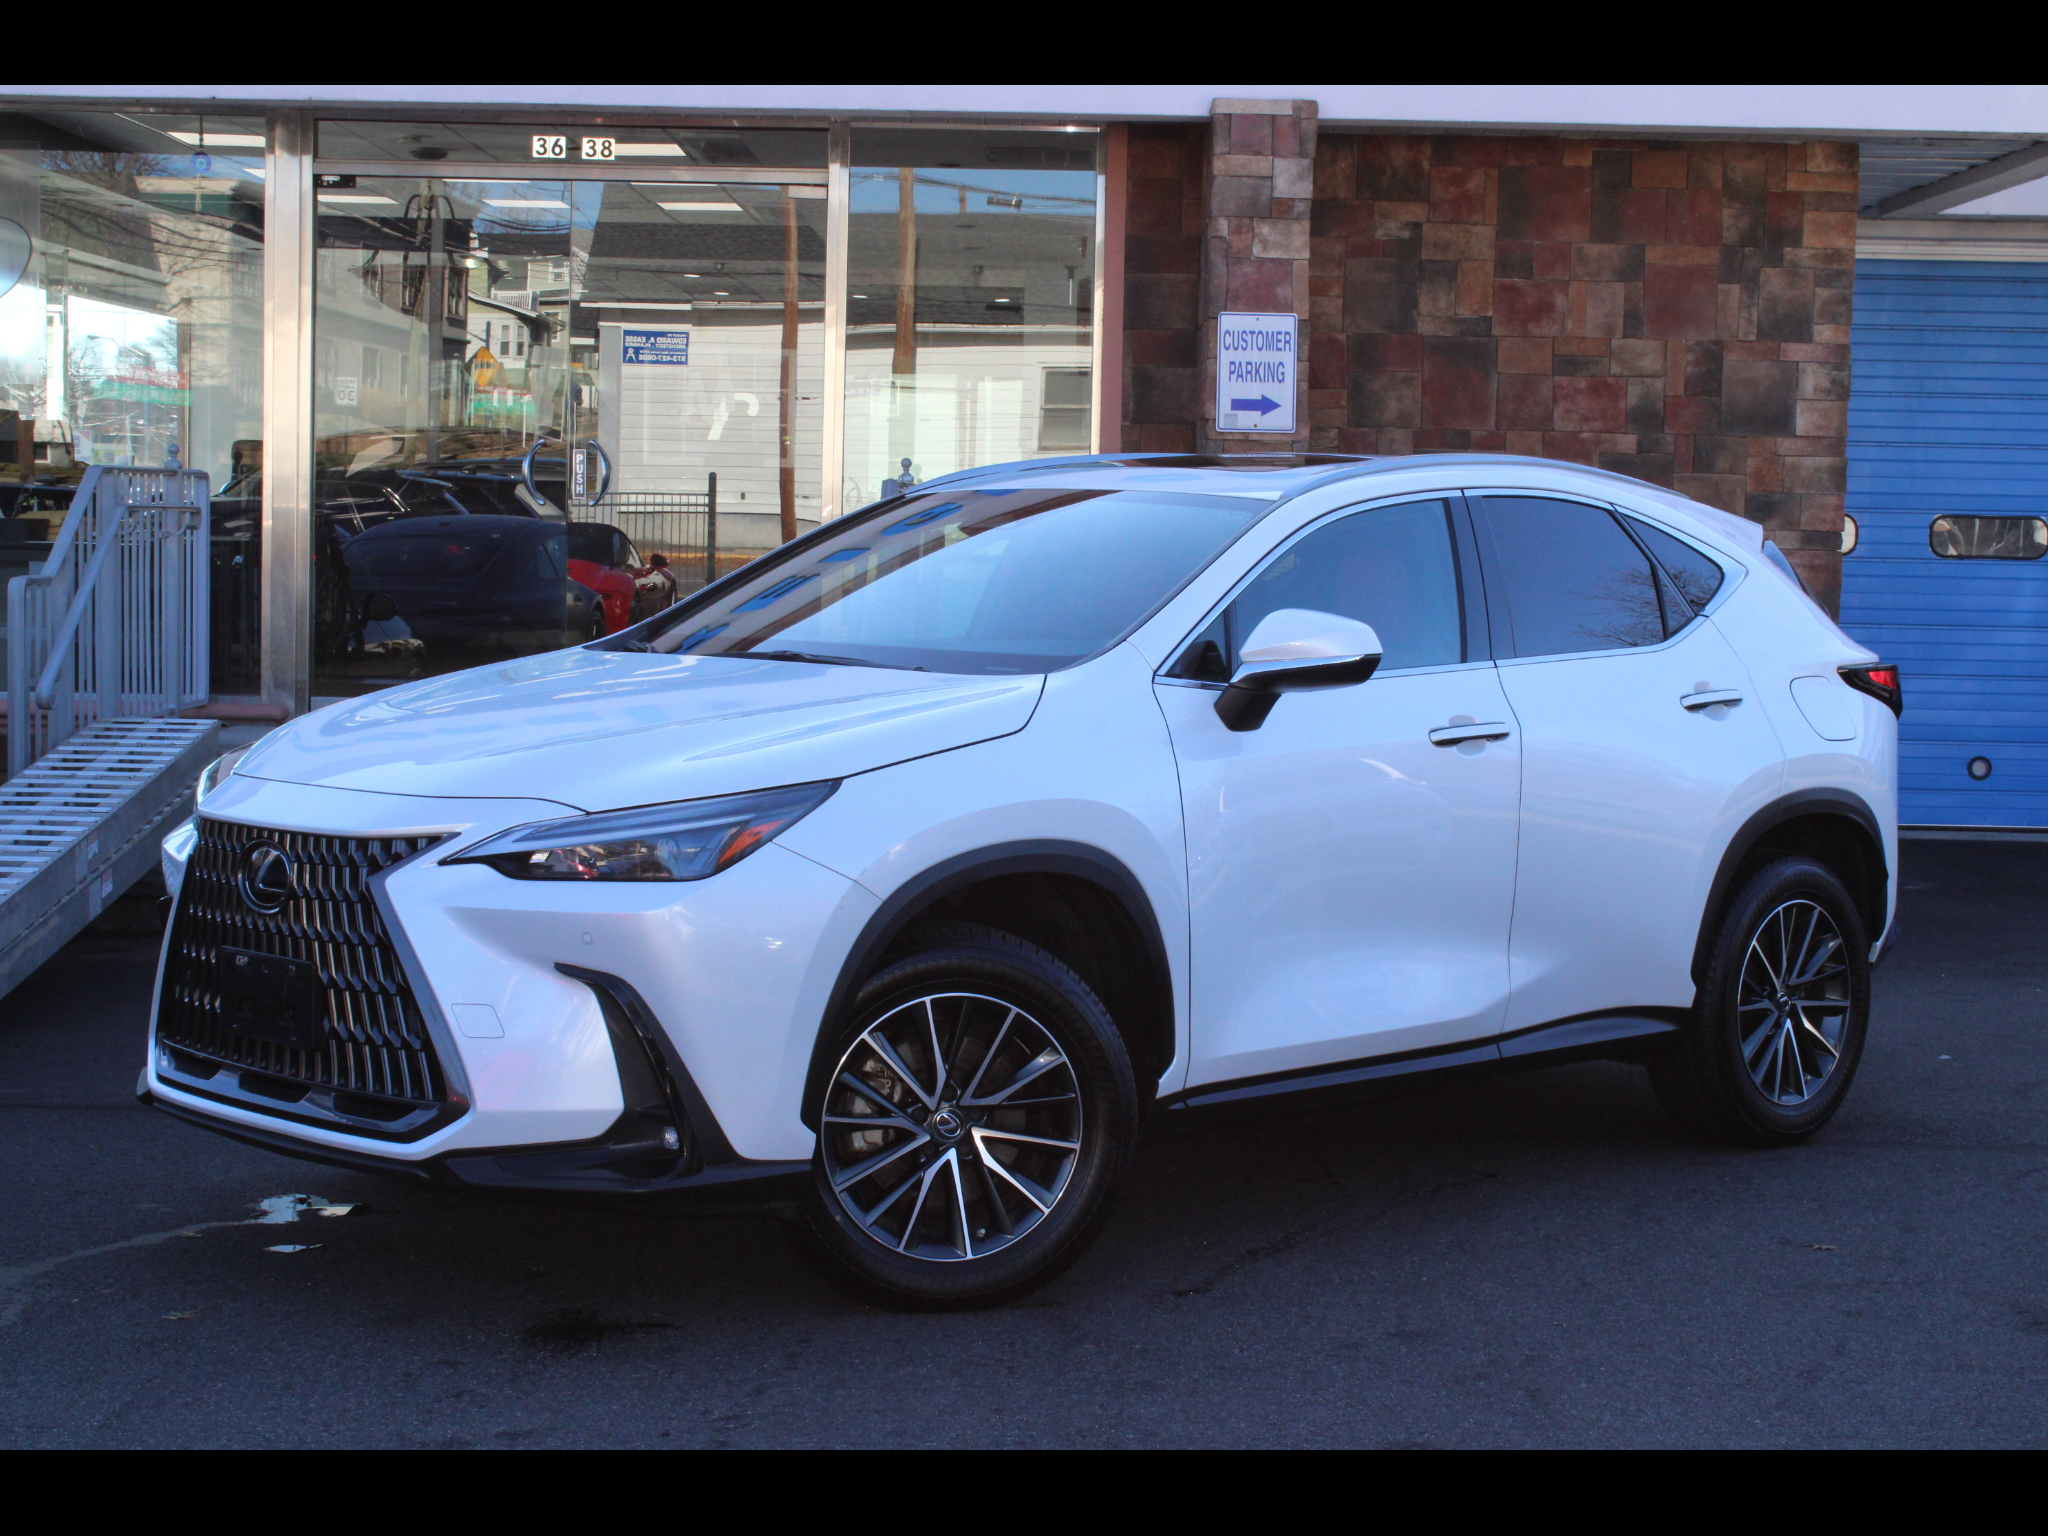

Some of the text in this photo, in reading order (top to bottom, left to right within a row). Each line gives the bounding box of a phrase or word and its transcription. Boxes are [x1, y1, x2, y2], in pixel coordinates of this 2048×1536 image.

[535, 137, 613, 158] 36 38
[1223, 329, 1292, 352] CUSTOMER
[1228, 360, 1285, 384] PARKING
[576, 454, 584, 494] PUSH
